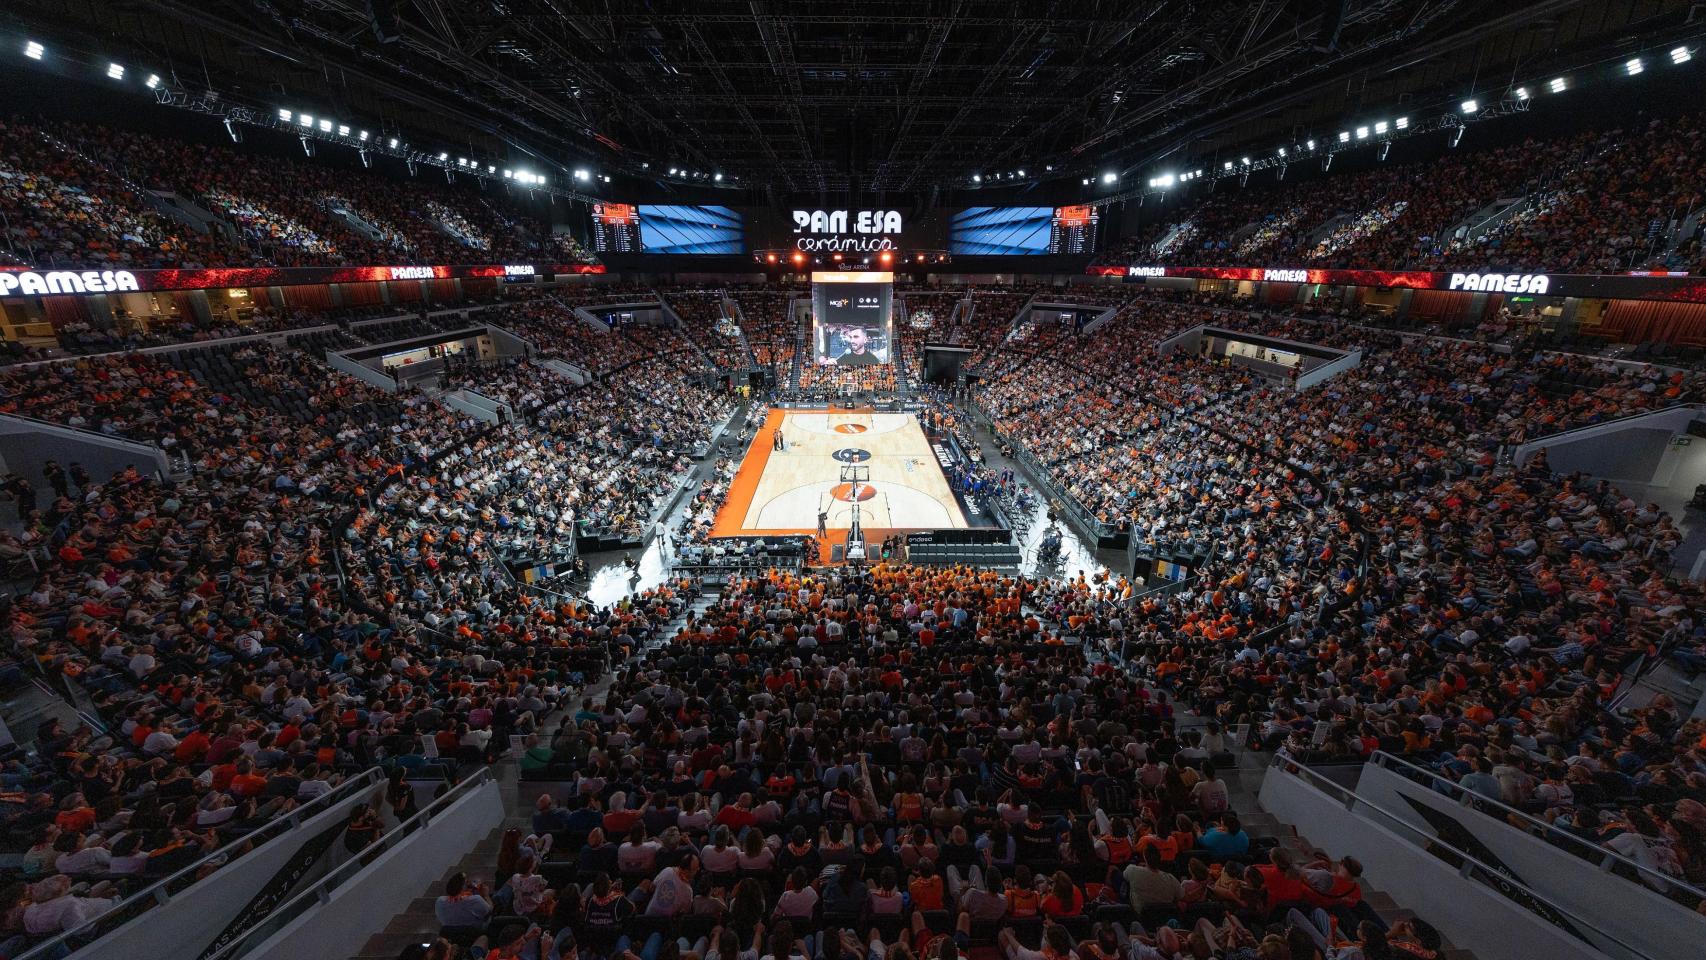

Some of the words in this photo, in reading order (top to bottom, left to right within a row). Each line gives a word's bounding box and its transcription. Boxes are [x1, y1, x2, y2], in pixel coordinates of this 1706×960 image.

[391, 267, 434, 279] PAMESA
[505, 266, 534, 275] PAMESA
[1129, 266, 1166, 278] PAMESA
[1264, 268, 1308, 283] PAMESA
[0, 271, 139, 295] PAMESA
[1449, 272, 1550, 294] PAMESA
